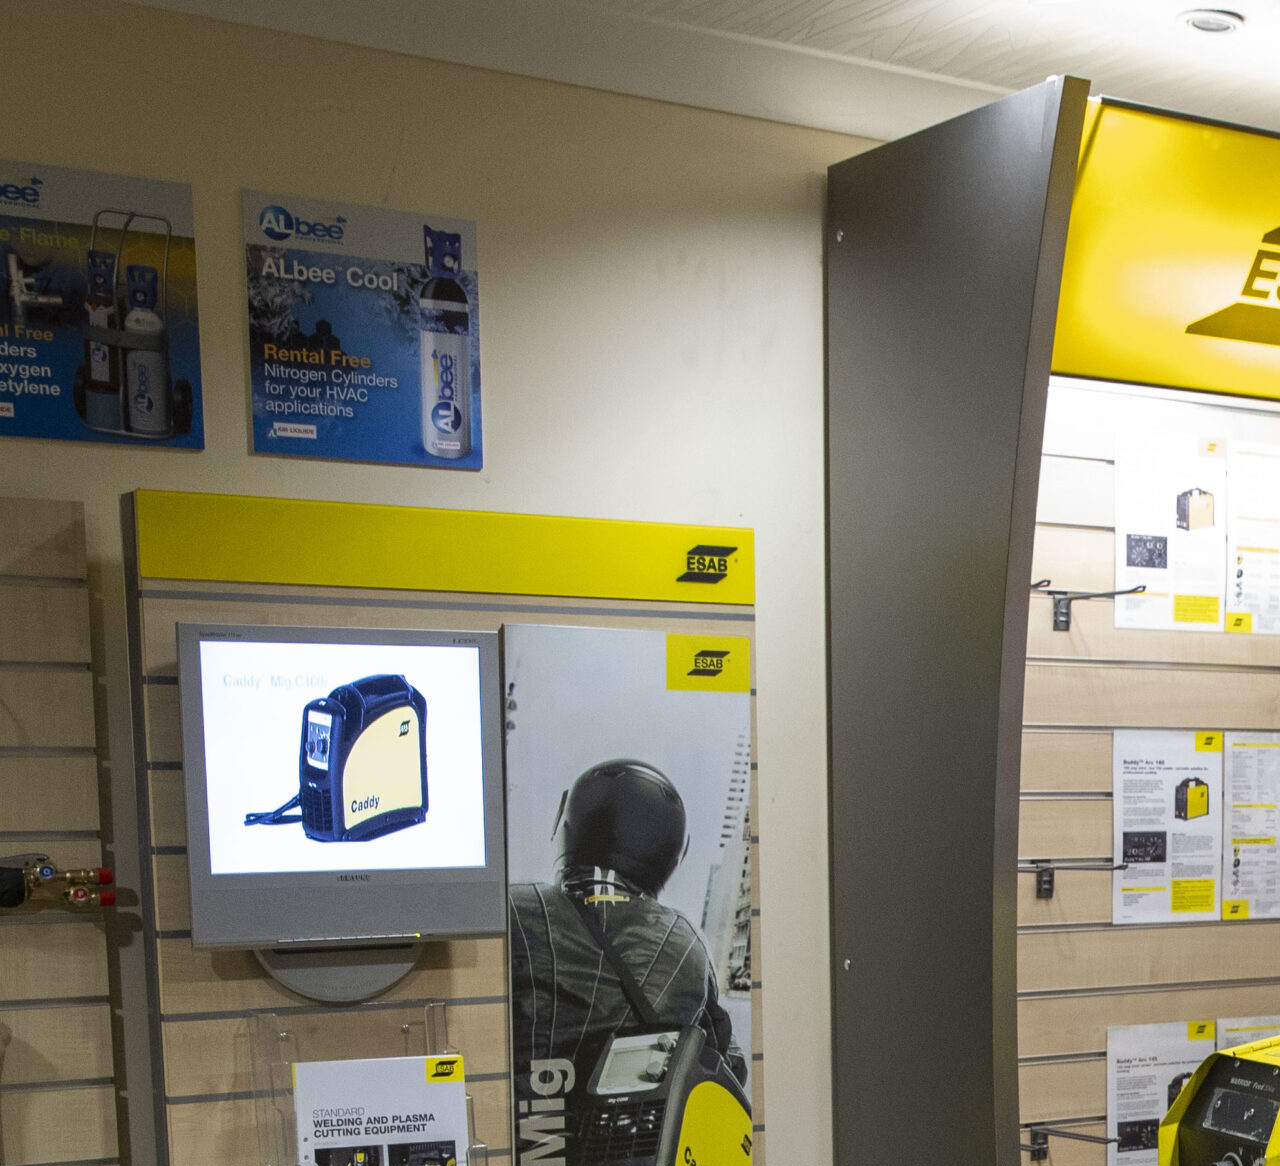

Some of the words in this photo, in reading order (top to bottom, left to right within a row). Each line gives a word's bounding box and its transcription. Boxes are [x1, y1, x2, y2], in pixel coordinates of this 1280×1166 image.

[20, 227, 81, 250] Flame
[346, 266, 398, 291] Cool
[14, 324, 54, 342] Free
[264, 343, 325, 364] Rental
[330, 350, 371, 369] Free
[264, 363, 327, 384] Nitrogen
[331, 369, 398, 388] Cylinders
[264, 380, 286, 395] for
[288, 385, 322, 401] your
[326, 387, 369, 402] HVAC
[264, 401, 354, 418] applications
[686, 556, 728, 572] ESAB
[694, 657, 724, 669] ESAB
[222, 674, 261, 690] Caddy
[270, 675, 292, 690] Mig
[350, 797, 380, 813] Caddy
[436, 1065, 455, 1074] ESAB
[312, 1107, 366, 1119] STANDARD
[313, 1117, 363, 1129] WELDING
[366, 1115, 389, 1125] AND
[391, 1113, 436, 1124] PLASMA
[314, 1128, 361, 1139] CUTTING
[364, 1123, 428, 1136] EQUIPMENT
